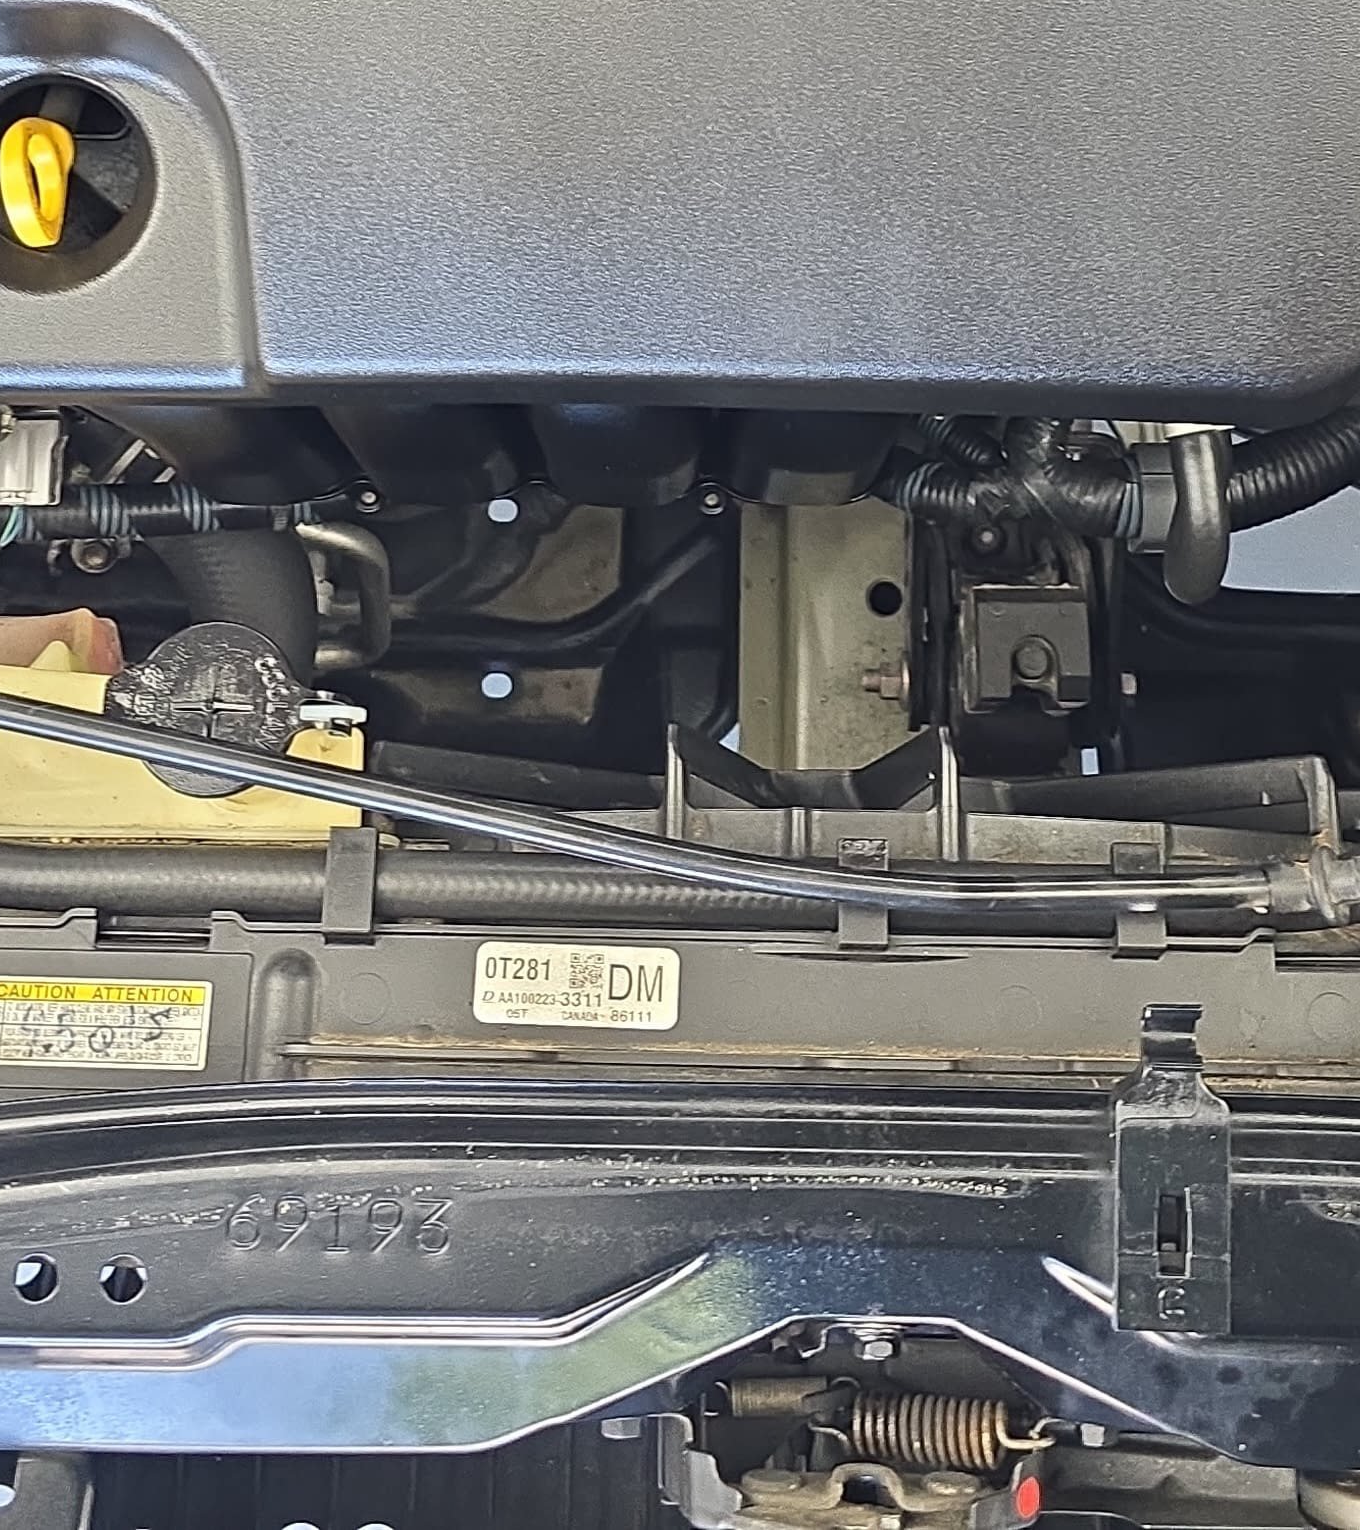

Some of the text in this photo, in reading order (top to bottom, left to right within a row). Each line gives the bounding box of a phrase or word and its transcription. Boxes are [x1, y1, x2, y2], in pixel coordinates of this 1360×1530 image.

[92, 986, 193, 1003] ATTENTION
[607, 963, 664, 1003] DM
[610, 1010, 652, 1023] 86111
[224, 1192, 454, 1257] 69193
